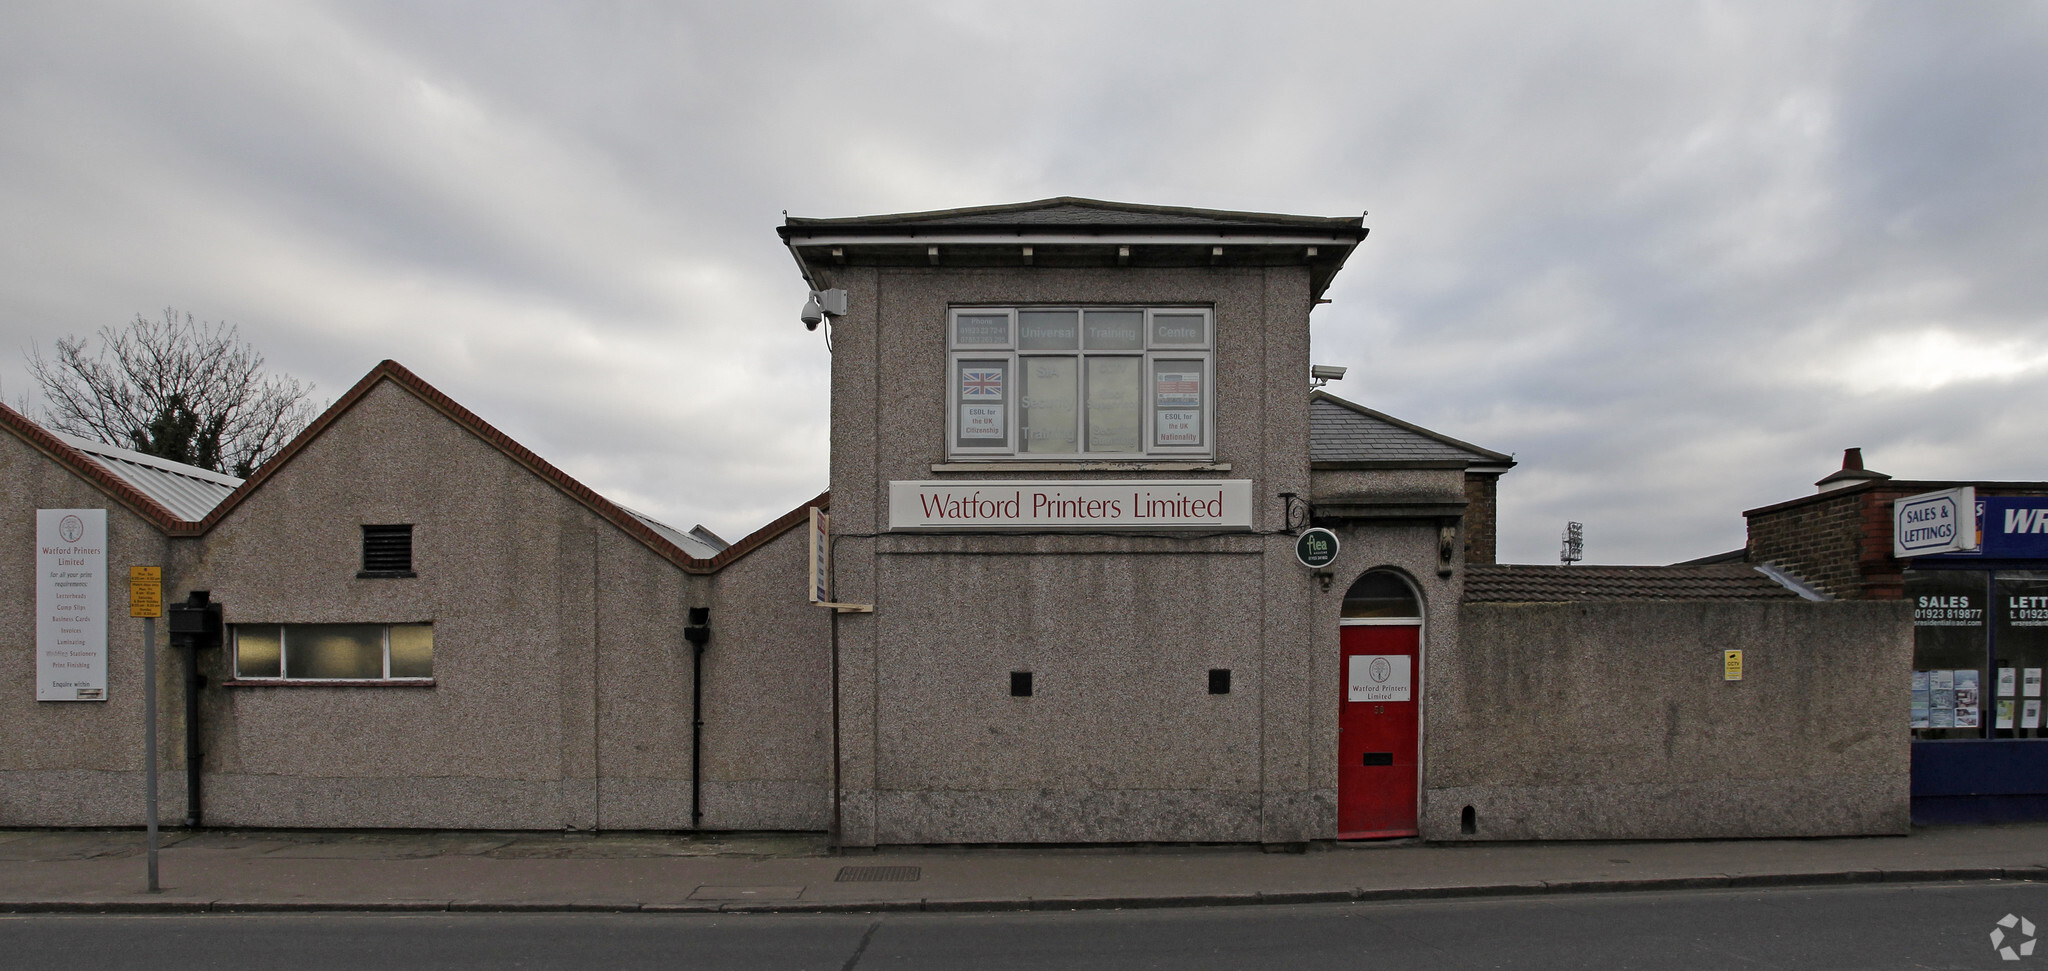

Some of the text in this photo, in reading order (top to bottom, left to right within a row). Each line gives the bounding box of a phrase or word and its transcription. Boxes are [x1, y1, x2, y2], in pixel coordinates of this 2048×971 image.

[971, 317, 993, 325] Phone
[1021, 325, 1197, 341] Universal Training Centre
[969, 408, 996, 416] ESOL for
[1164, 413, 1182, 421] ESOL
[966, 427, 1000, 435] Citizenship
[1021, 425, 1076, 443] Training
[1160, 433, 1197, 442] Nationality
[920, 491, 1223, 519] Watford Printers Limited
[1907, 505, 1949, 524] SALES &
[1904, 524, 1952, 543] LETTINGS
[1306, 534, 1328, 556] flea
[42, 546, 101, 555] Watford Printers
[58, 558, 85, 566] Limited
[80, 571, 93, 579] print
[56, 592, 87, 600] Letterheads
[1918, 595, 1970, 609] SALES
[2009, 596, 2048, 608] LETT
[1914, 608, 1983, 619] 01923 819877
[2019, 608, 2048, 619] 01923
[57, 638, 86, 646] Laminating
[66, 661, 90, 669] Finishing
[52, 680, 72, 688] Enquire
[1352, 684, 1408, 693] Watford Printers
